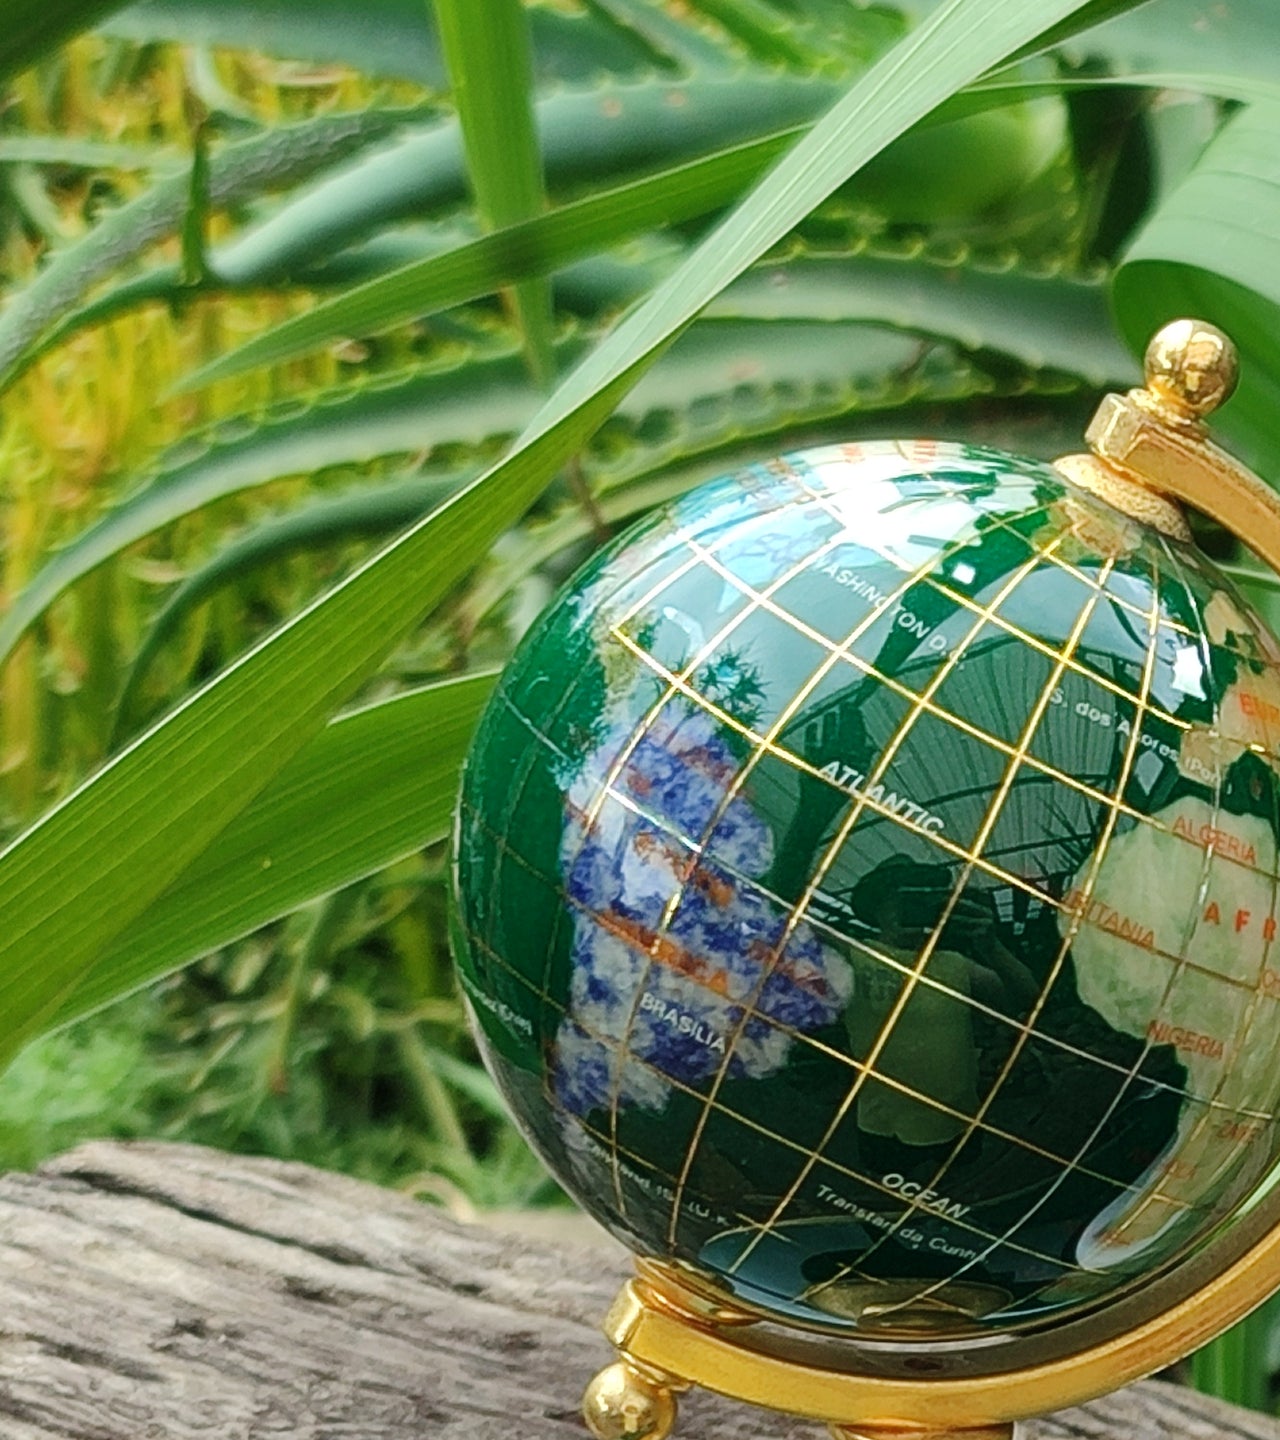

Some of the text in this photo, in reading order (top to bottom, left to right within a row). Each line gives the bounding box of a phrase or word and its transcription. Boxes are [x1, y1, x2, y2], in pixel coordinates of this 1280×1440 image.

[819, 760, 945, 838] ATLANTIC
[1172, 815, 1257, 866] ALGERIA
[640, 991, 728, 1055] BRASILIA
[1146, 1019, 1225, 1060] NIGERIA
[882, 1173, 970, 1218] OCEAN
